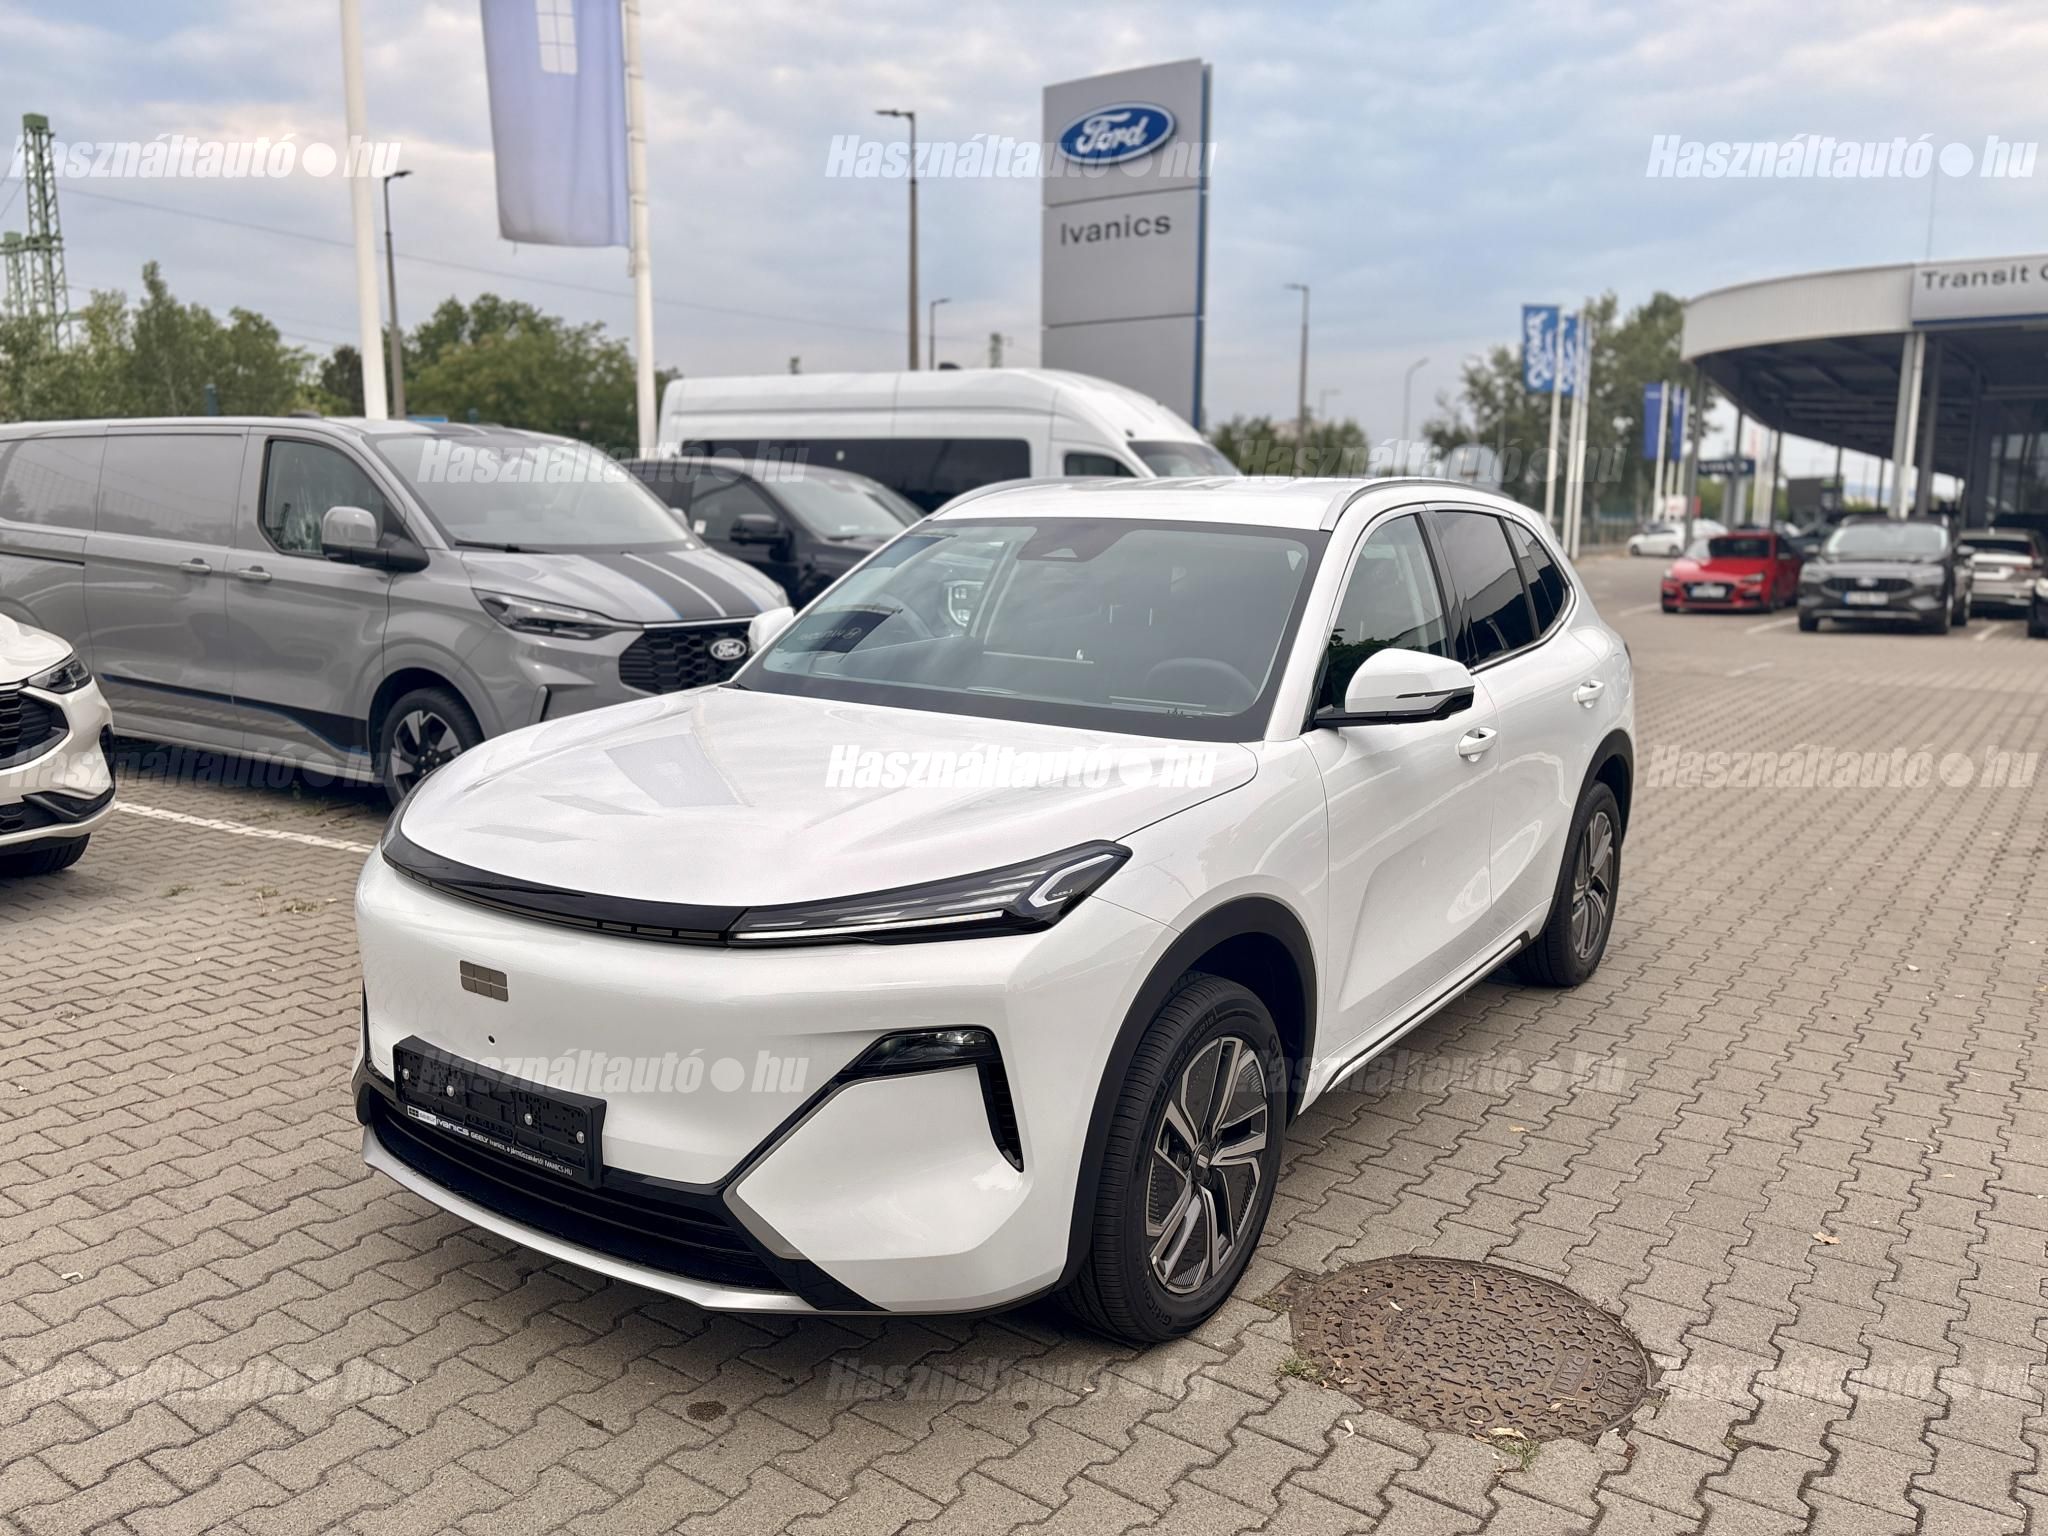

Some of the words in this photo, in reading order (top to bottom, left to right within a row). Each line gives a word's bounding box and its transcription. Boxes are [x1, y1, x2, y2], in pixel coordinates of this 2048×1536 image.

[1075, 112, 1149, 154] Ford
[1060, 213, 1171, 246] Ivanics
[1921, 264, 2029, 290] Transit
[717, 642, 741, 657] Ford
